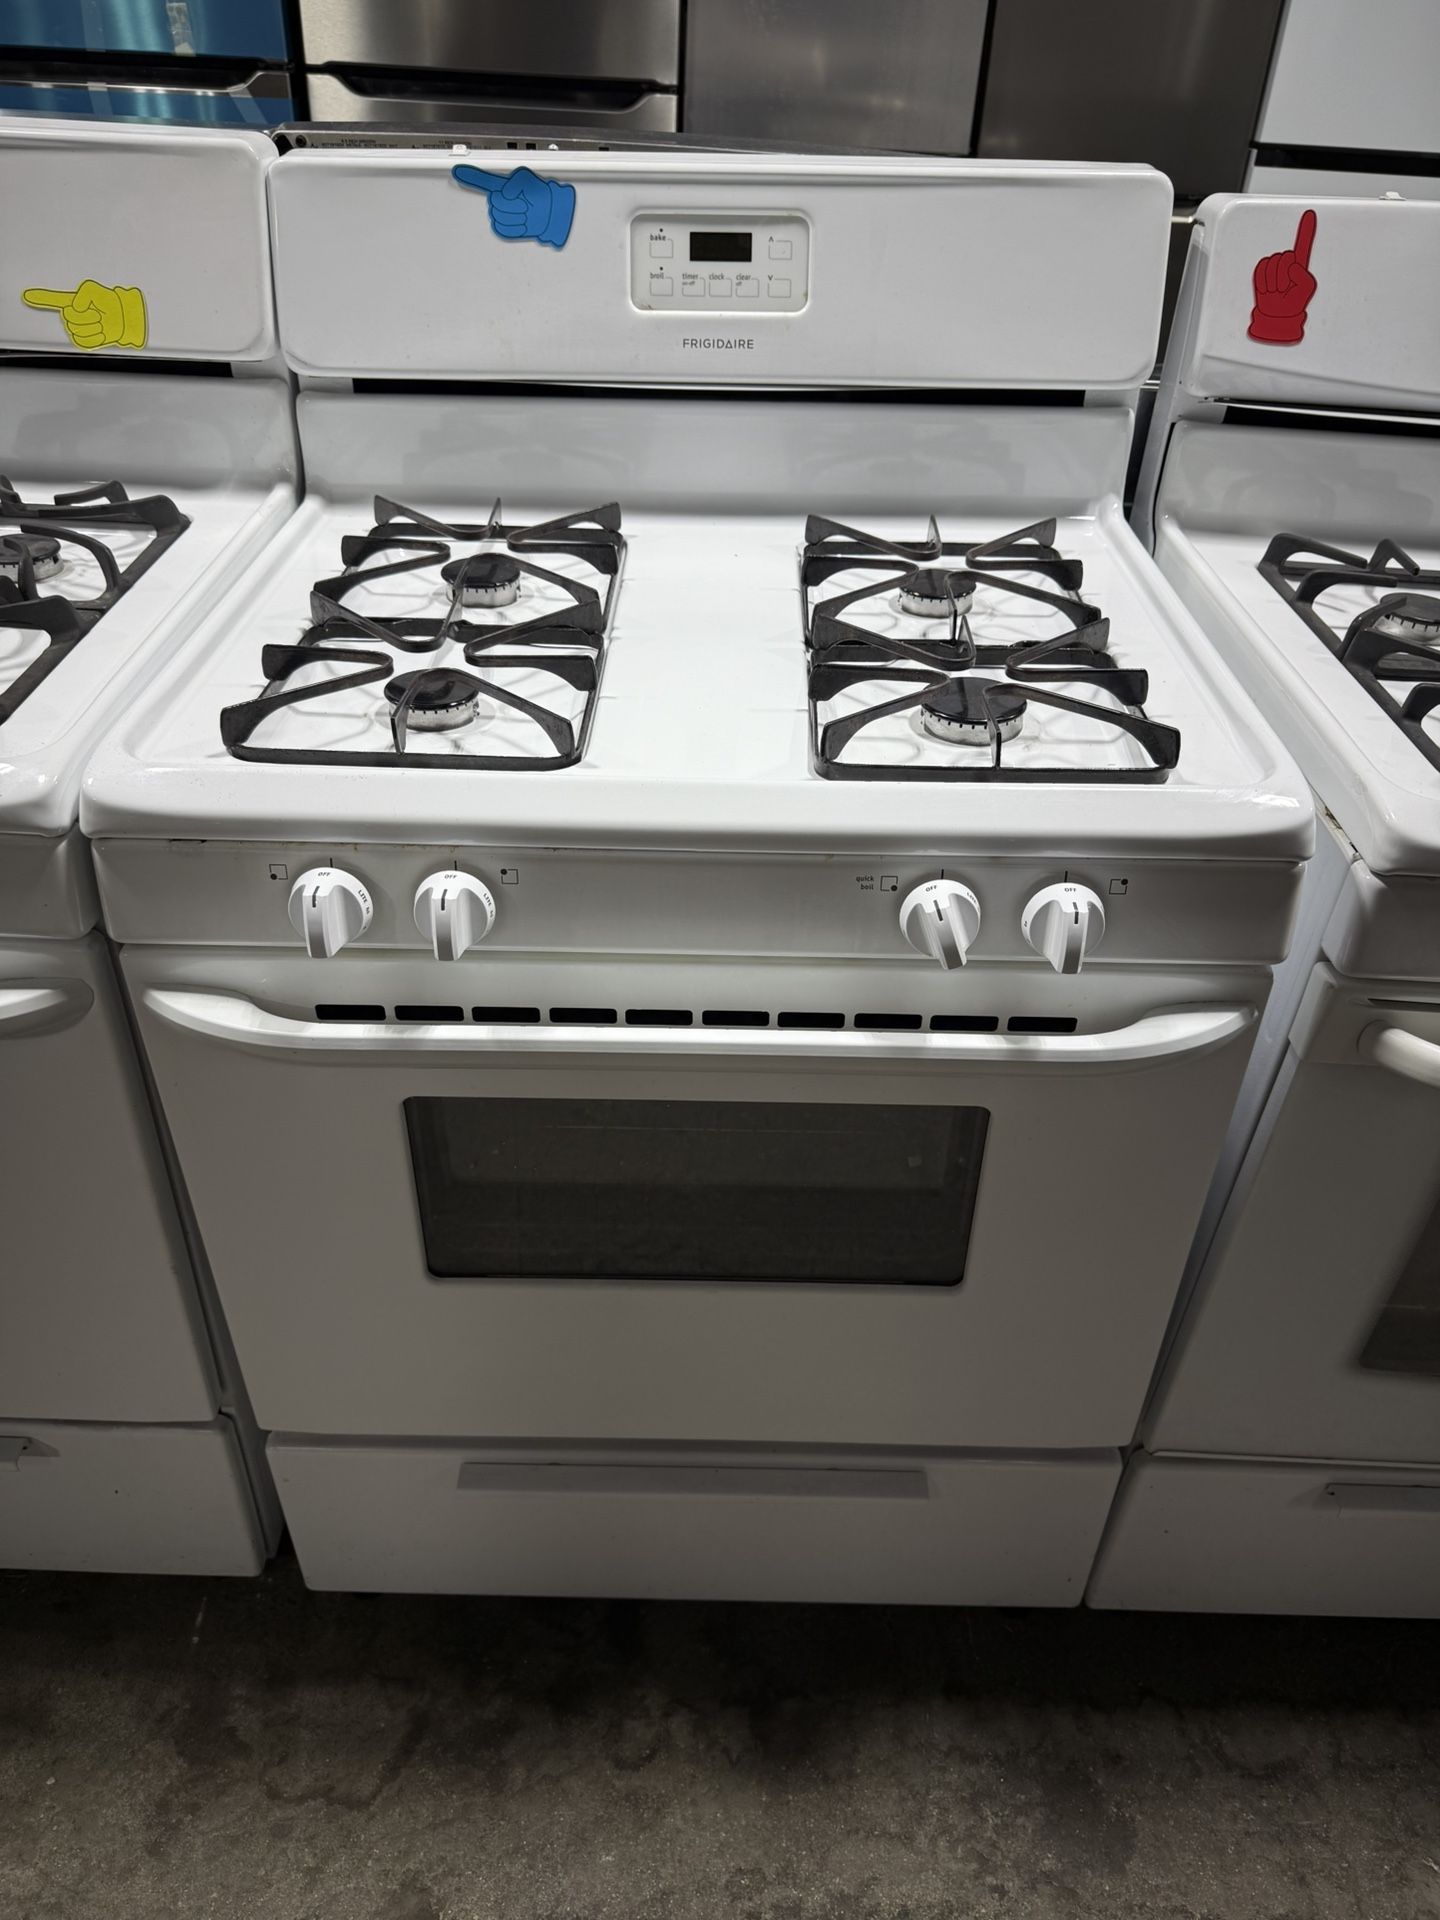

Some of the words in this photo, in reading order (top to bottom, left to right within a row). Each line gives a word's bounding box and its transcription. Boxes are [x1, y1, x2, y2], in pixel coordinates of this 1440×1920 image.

[650, 233, 666, 241] bake
[650, 272, 664, 280] broil
[682, 272, 698, 280] timer
[709, 272, 724, 280] clock
[736, 272, 751, 280] clear
[682, 338, 754, 350] FRIGIDAIRE
[856, 874, 874, 882] quick
[925, 884, 937, 892] OFF
[358, 889, 368, 903] LITE
[483, 893, 492, 906] LITE
